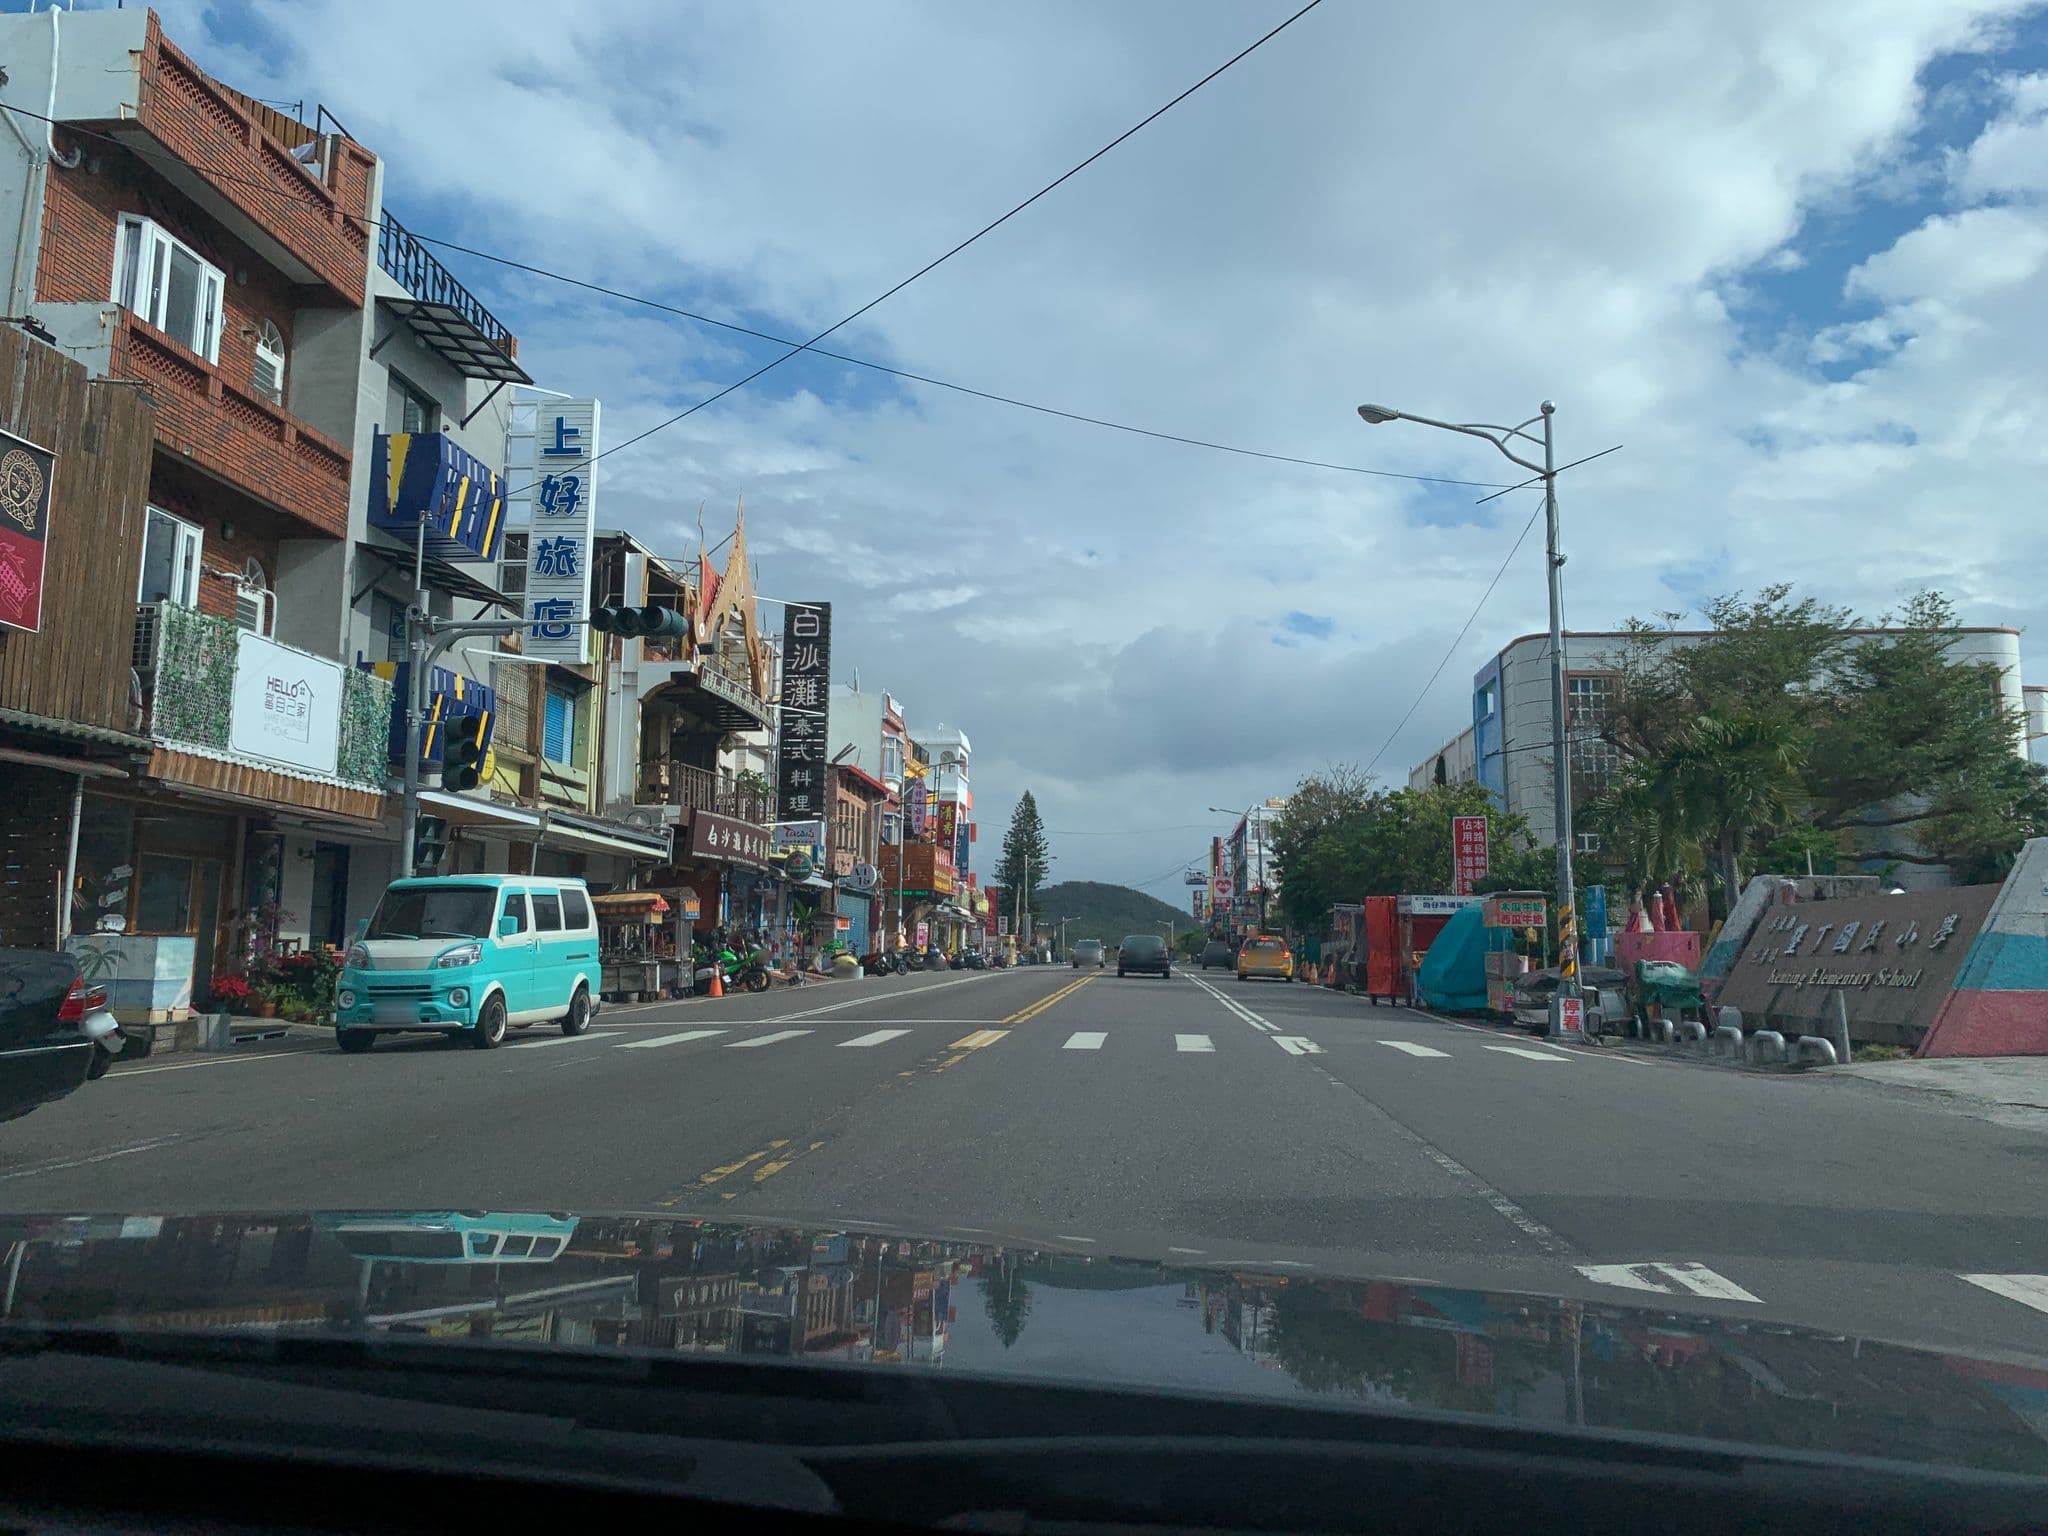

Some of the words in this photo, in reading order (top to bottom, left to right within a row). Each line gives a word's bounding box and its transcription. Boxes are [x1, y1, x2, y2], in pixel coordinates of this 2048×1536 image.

[531, 415, 583, 640] 上好旅店
[267, 675, 299, 698] HELLO
[788, 609, 820, 812] 白沙灘泰式料理
[1500, 914, 1544, 925] 西瓜牛奶
[1501, 902, 1543, 912] 木瓜牛奶
[1784, 913, 1959, 955] 墾丁國民小學
[1809, 968, 1873, 992] Elementary
[1875, 967, 1923, 989] School
[1563, 999, 1580, 1031] 停看
